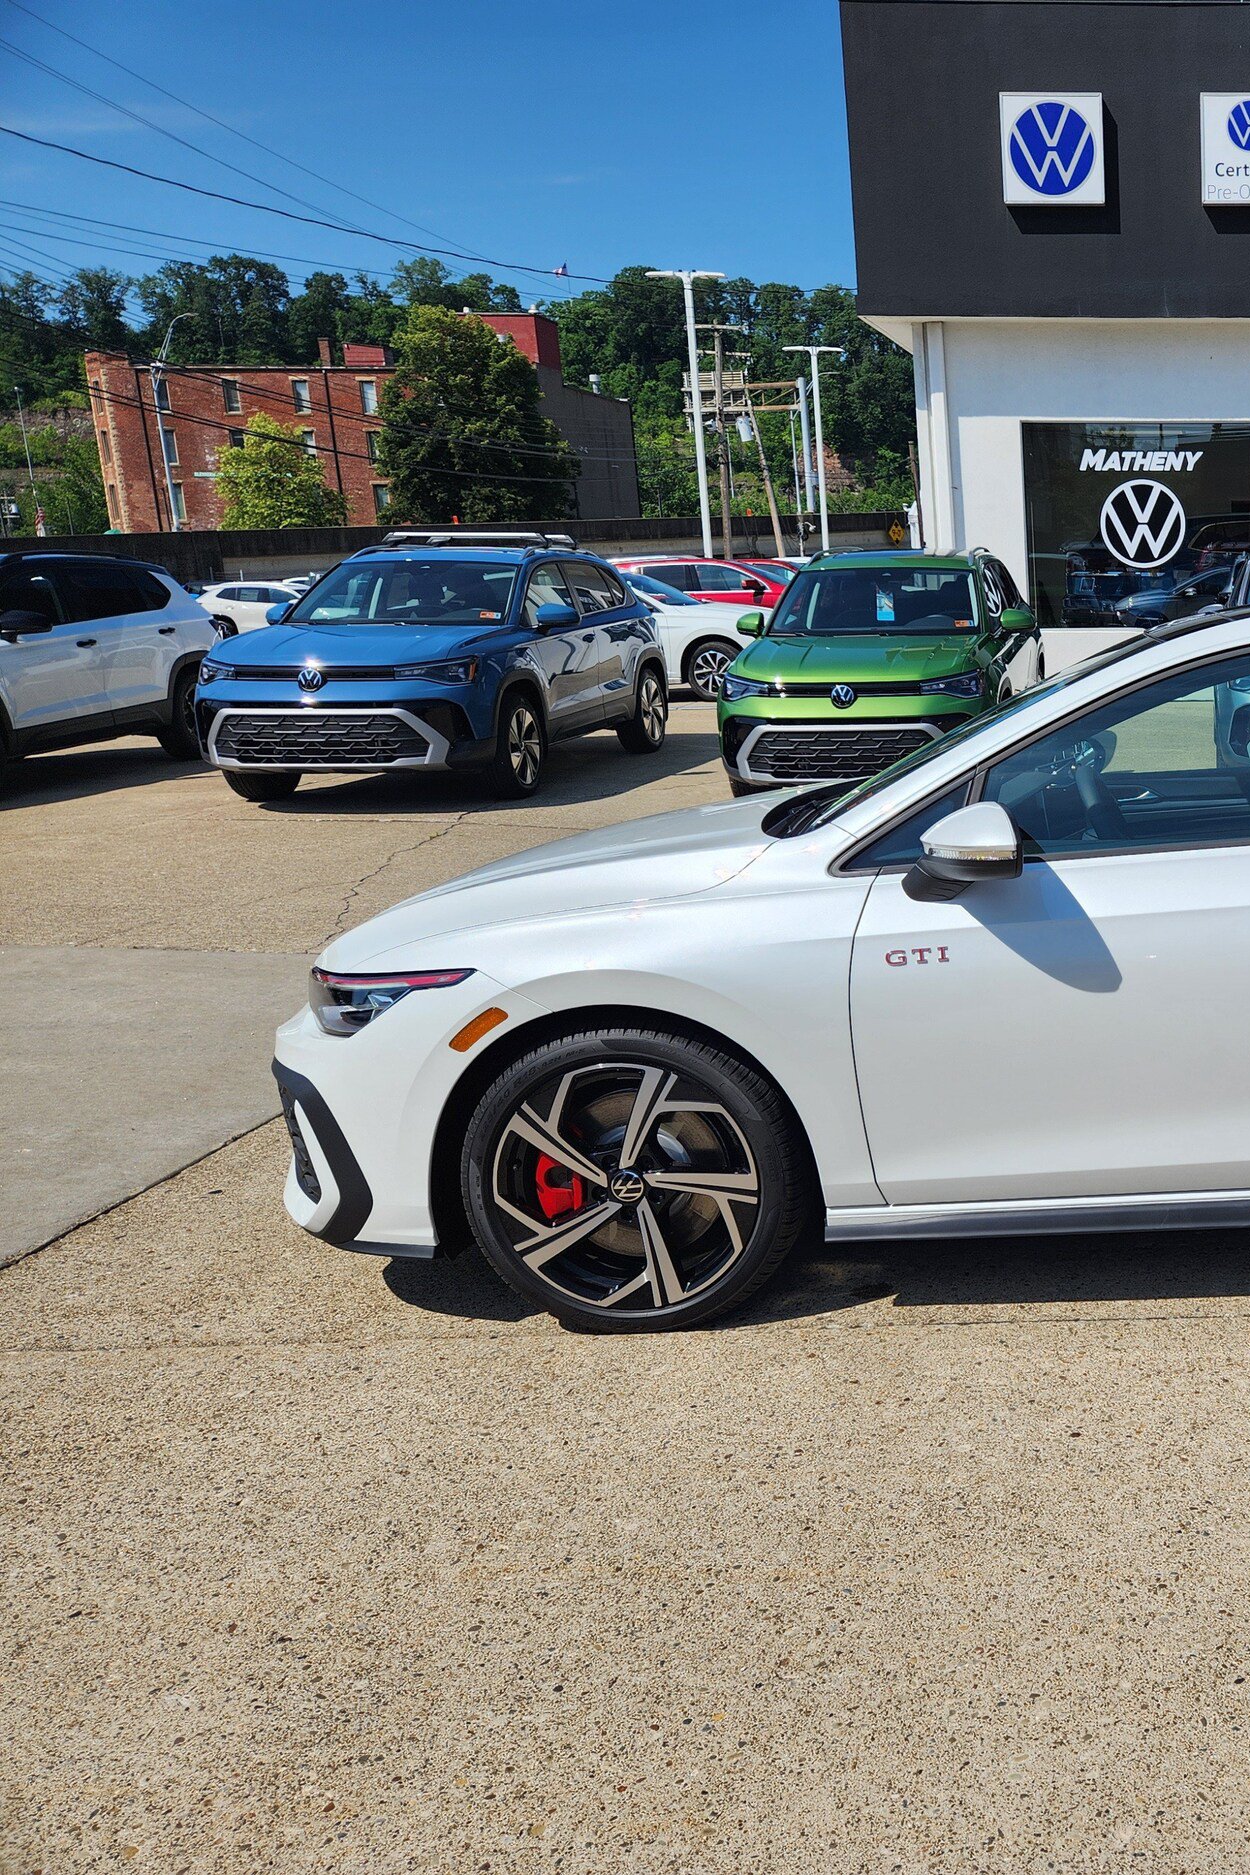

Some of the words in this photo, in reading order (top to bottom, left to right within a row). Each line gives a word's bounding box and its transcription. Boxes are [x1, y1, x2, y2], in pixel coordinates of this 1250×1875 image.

[1009, 100, 1096, 197] VW
[1079, 448, 1204, 472] MATHENY
[1100, 478, 1186, 569] VW
[885, 946, 950, 967] GTI
